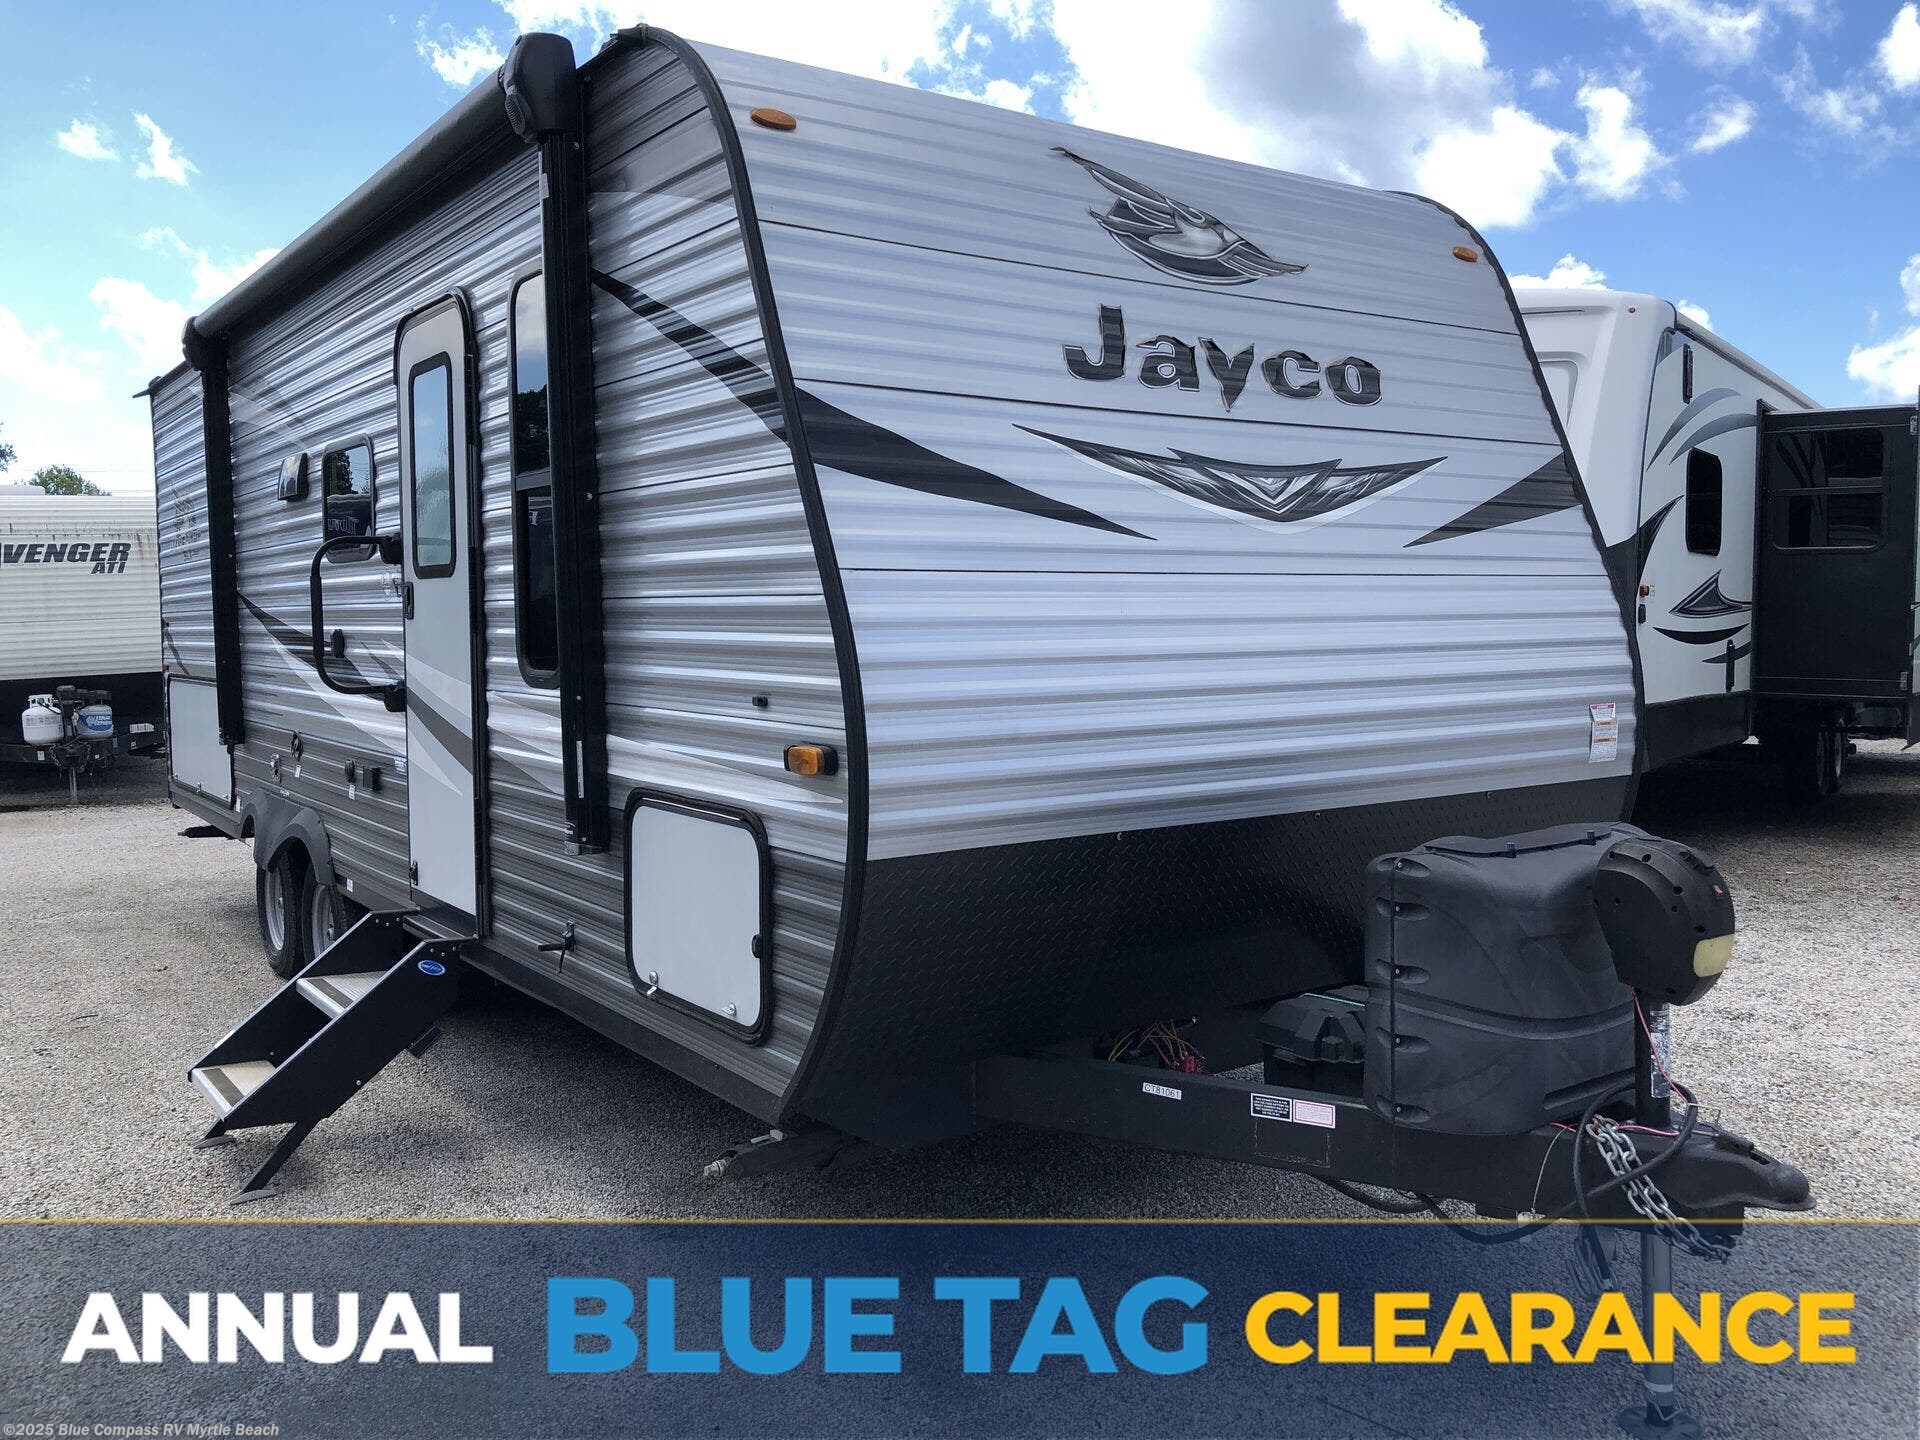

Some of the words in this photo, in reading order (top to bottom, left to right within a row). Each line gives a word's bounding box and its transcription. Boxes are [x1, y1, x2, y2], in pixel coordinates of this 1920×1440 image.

[1062, 303, 1382, 412] Jayco
[0, 542, 131, 567] VENGER
[91, 561, 126, 574] ATI
